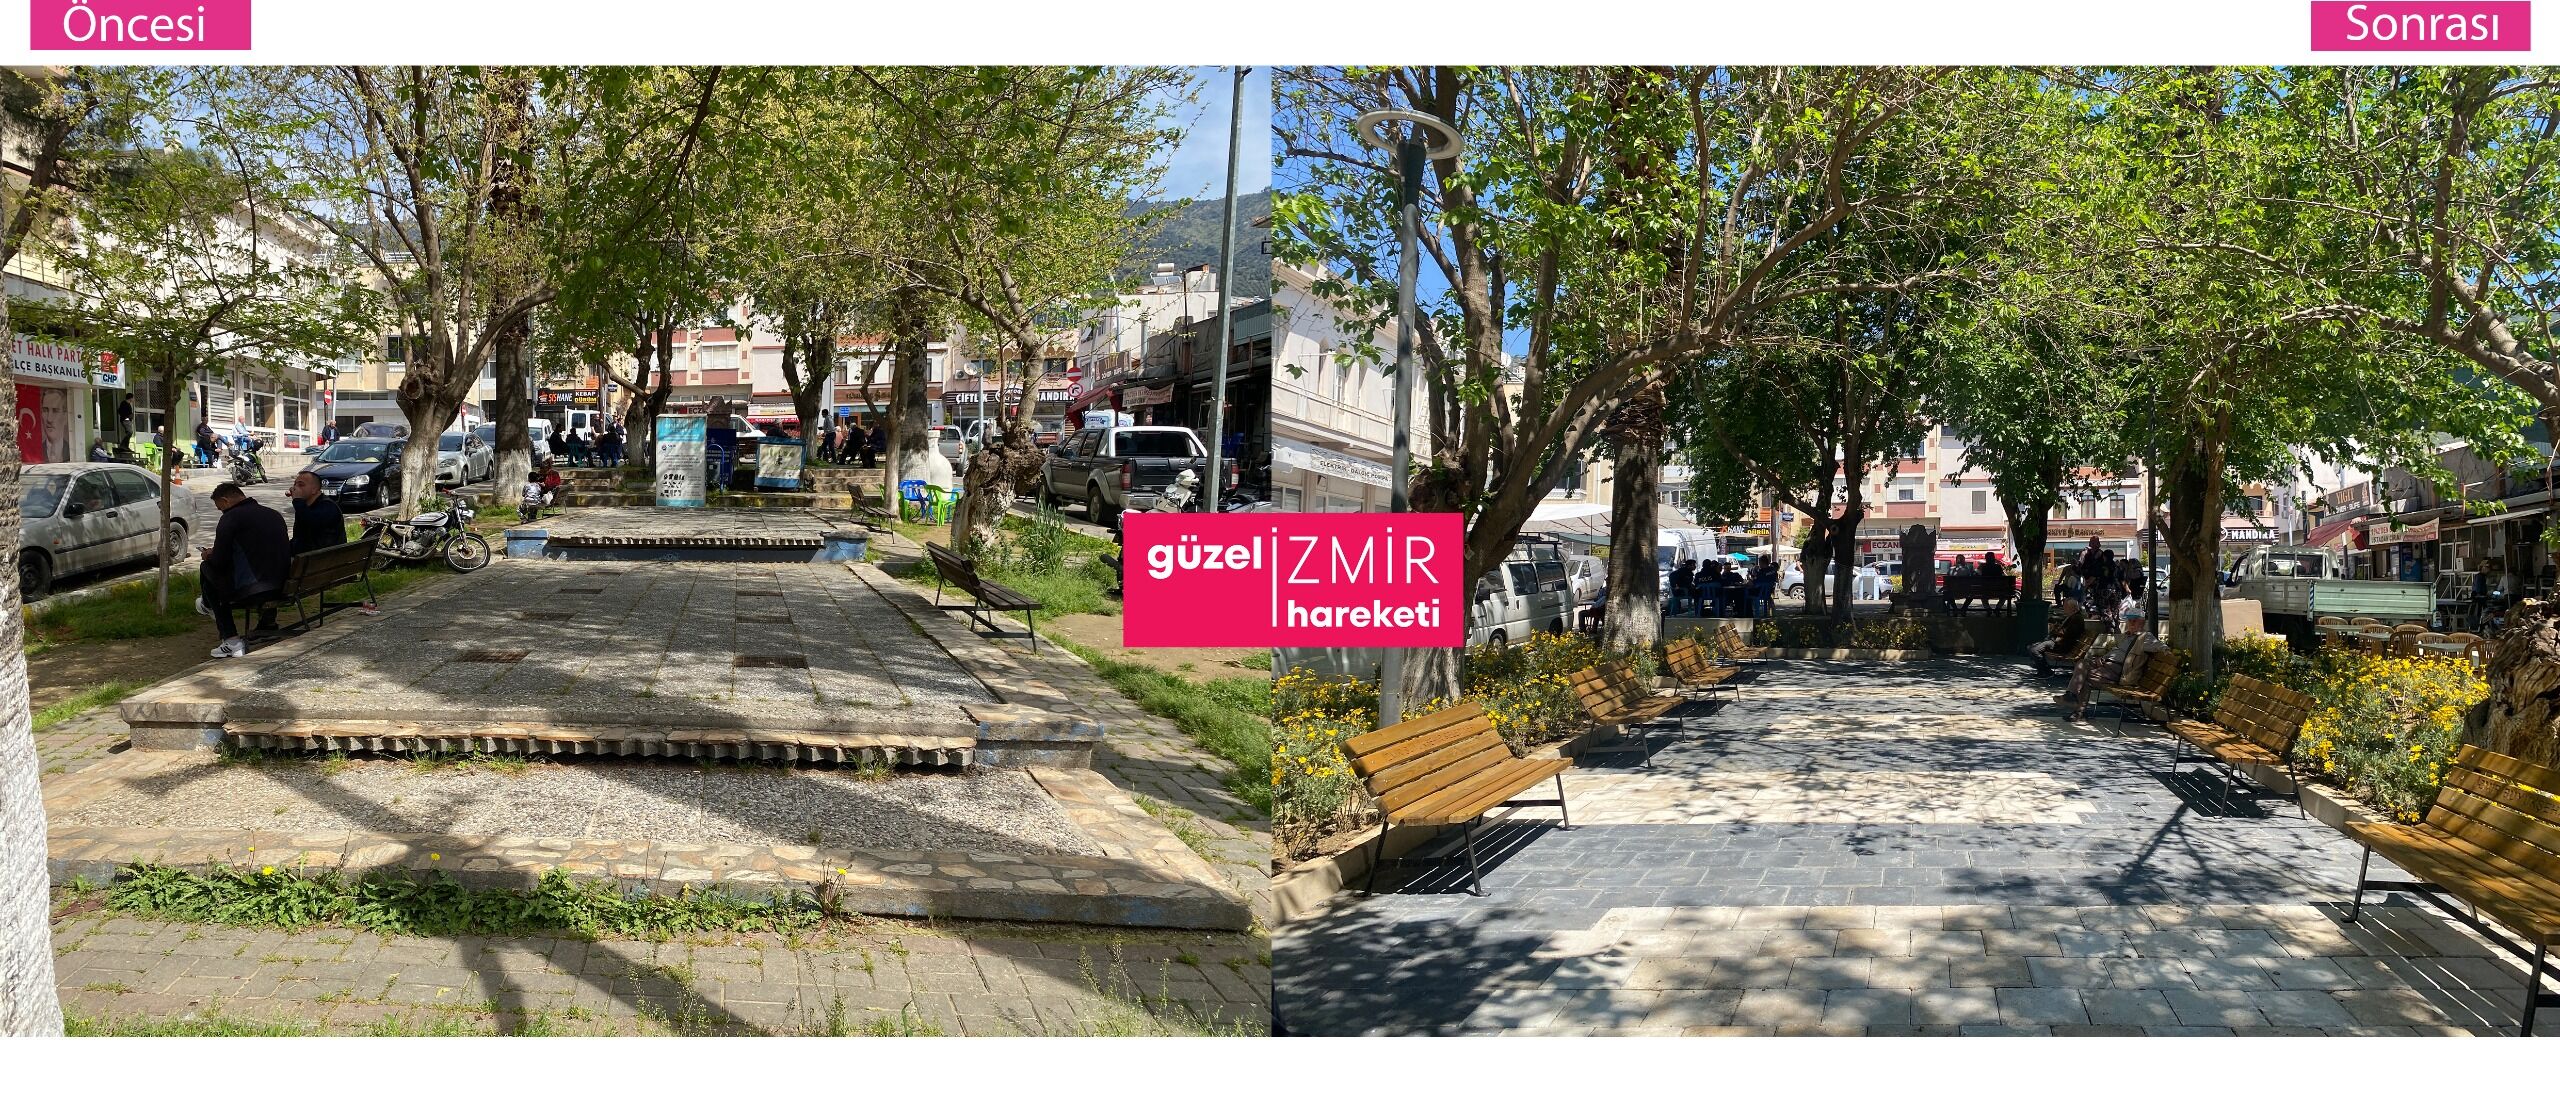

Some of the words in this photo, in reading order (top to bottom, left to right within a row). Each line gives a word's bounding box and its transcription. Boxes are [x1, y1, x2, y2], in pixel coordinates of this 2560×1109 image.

[27, 341, 53, 359] HALK
[57, 345, 82, 364] PART
[12, 359, 31, 372] LÇE
[35, 362, 87, 379] BAŞKANLIĞ
[102, 373, 117, 383] CHP
[955, 392, 988, 404] ÇİFTLK
[1872, 541, 1901, 549] ECZAN
